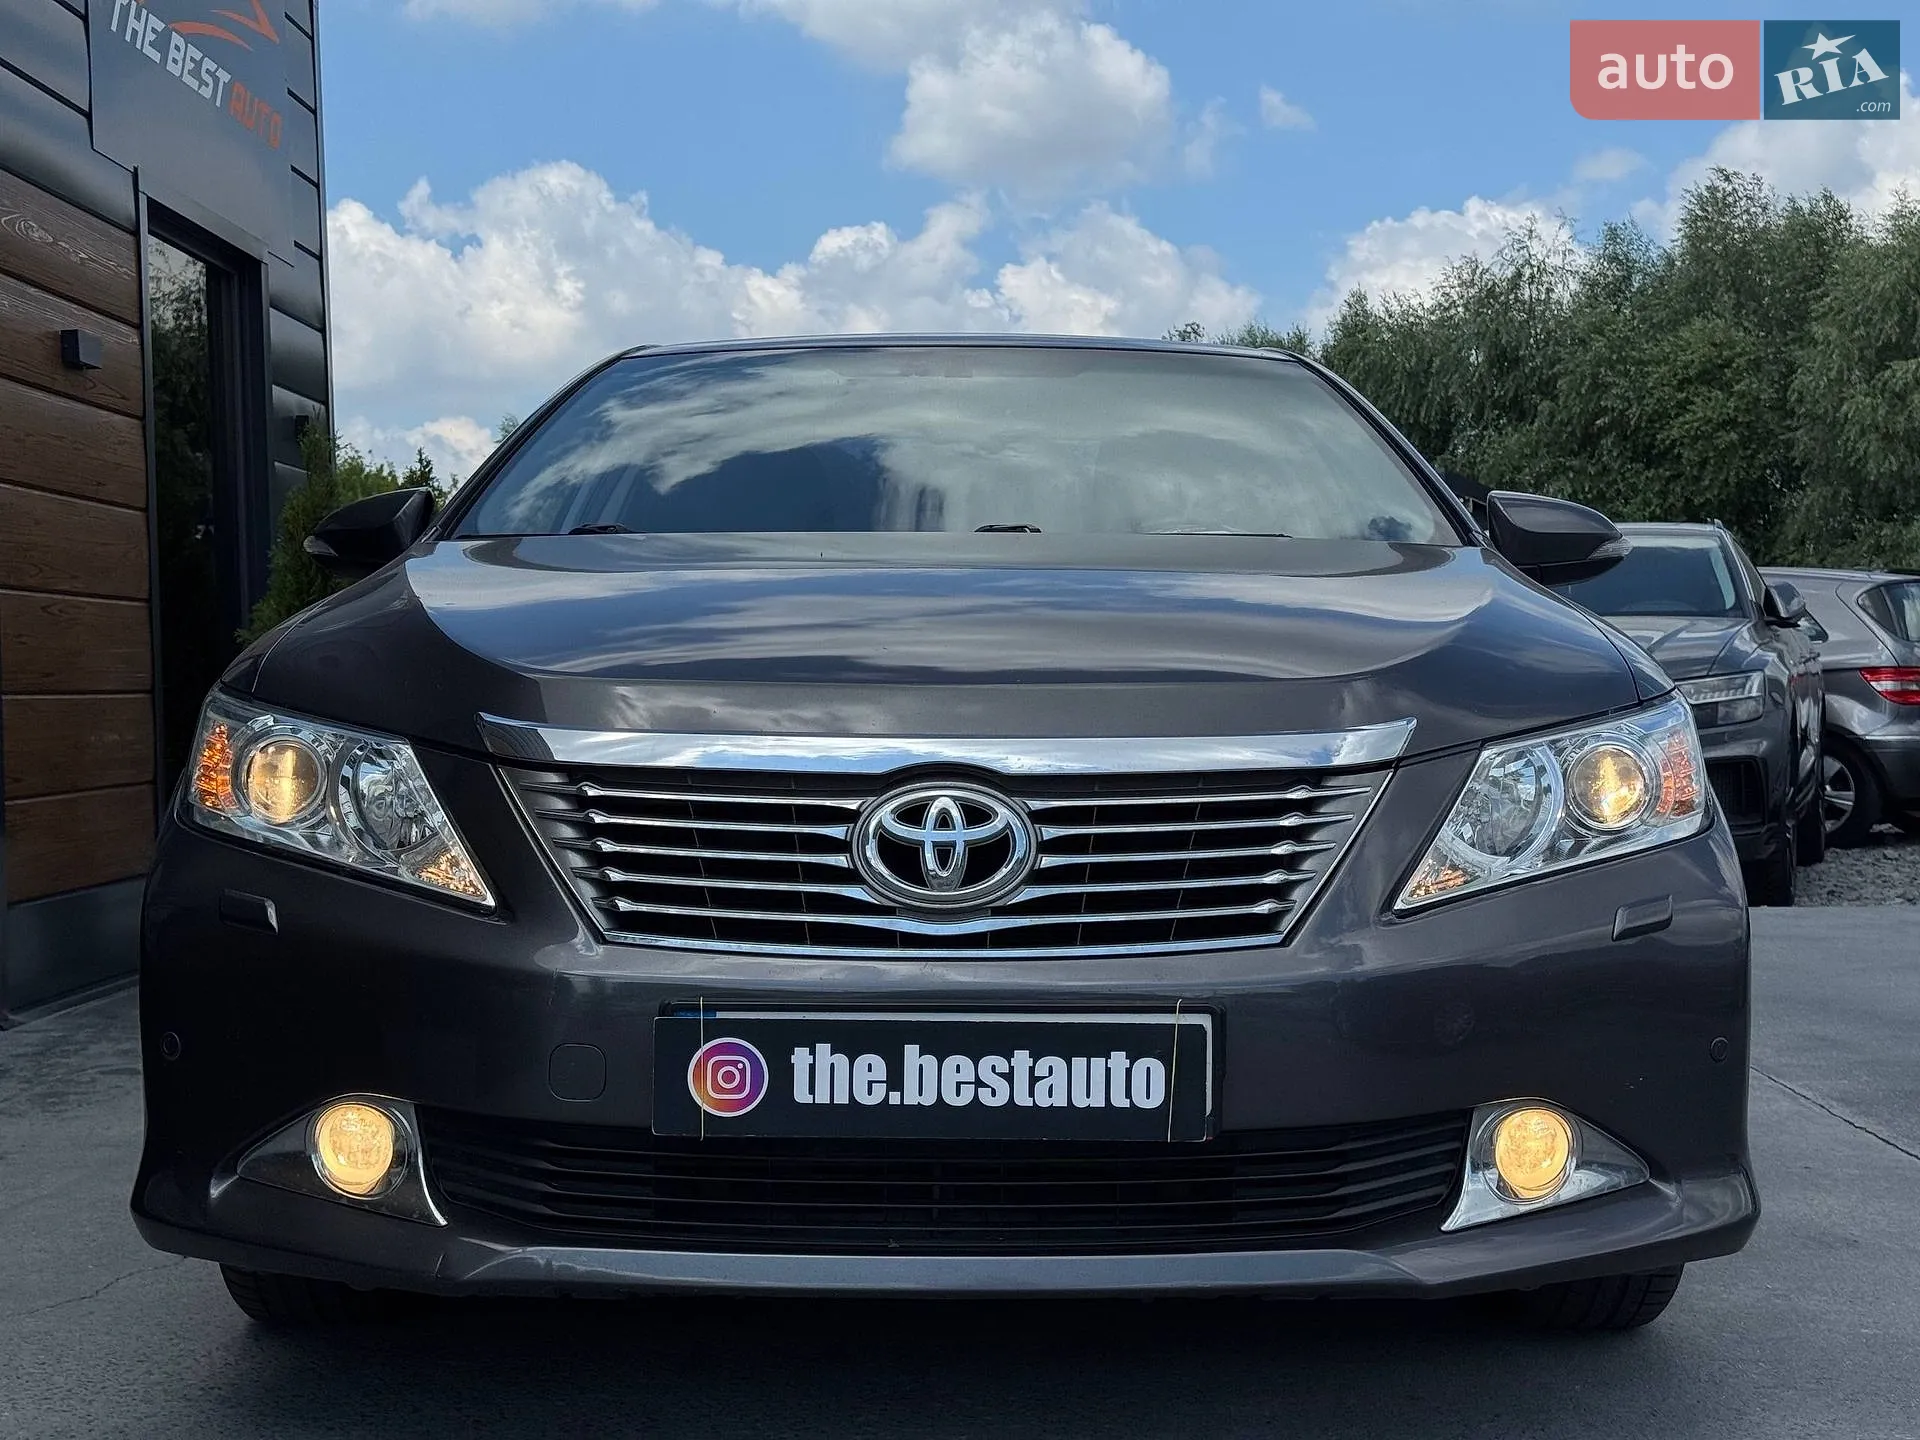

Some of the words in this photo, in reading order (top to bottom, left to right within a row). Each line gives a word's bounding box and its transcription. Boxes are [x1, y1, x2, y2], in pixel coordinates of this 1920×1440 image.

[110, 0, 167, 64] THE
[166, 31, 232, 108] BEST
[229, 82, 282, 149] AUTO
[791, 1043, 1166, 1110] the.bestauto
